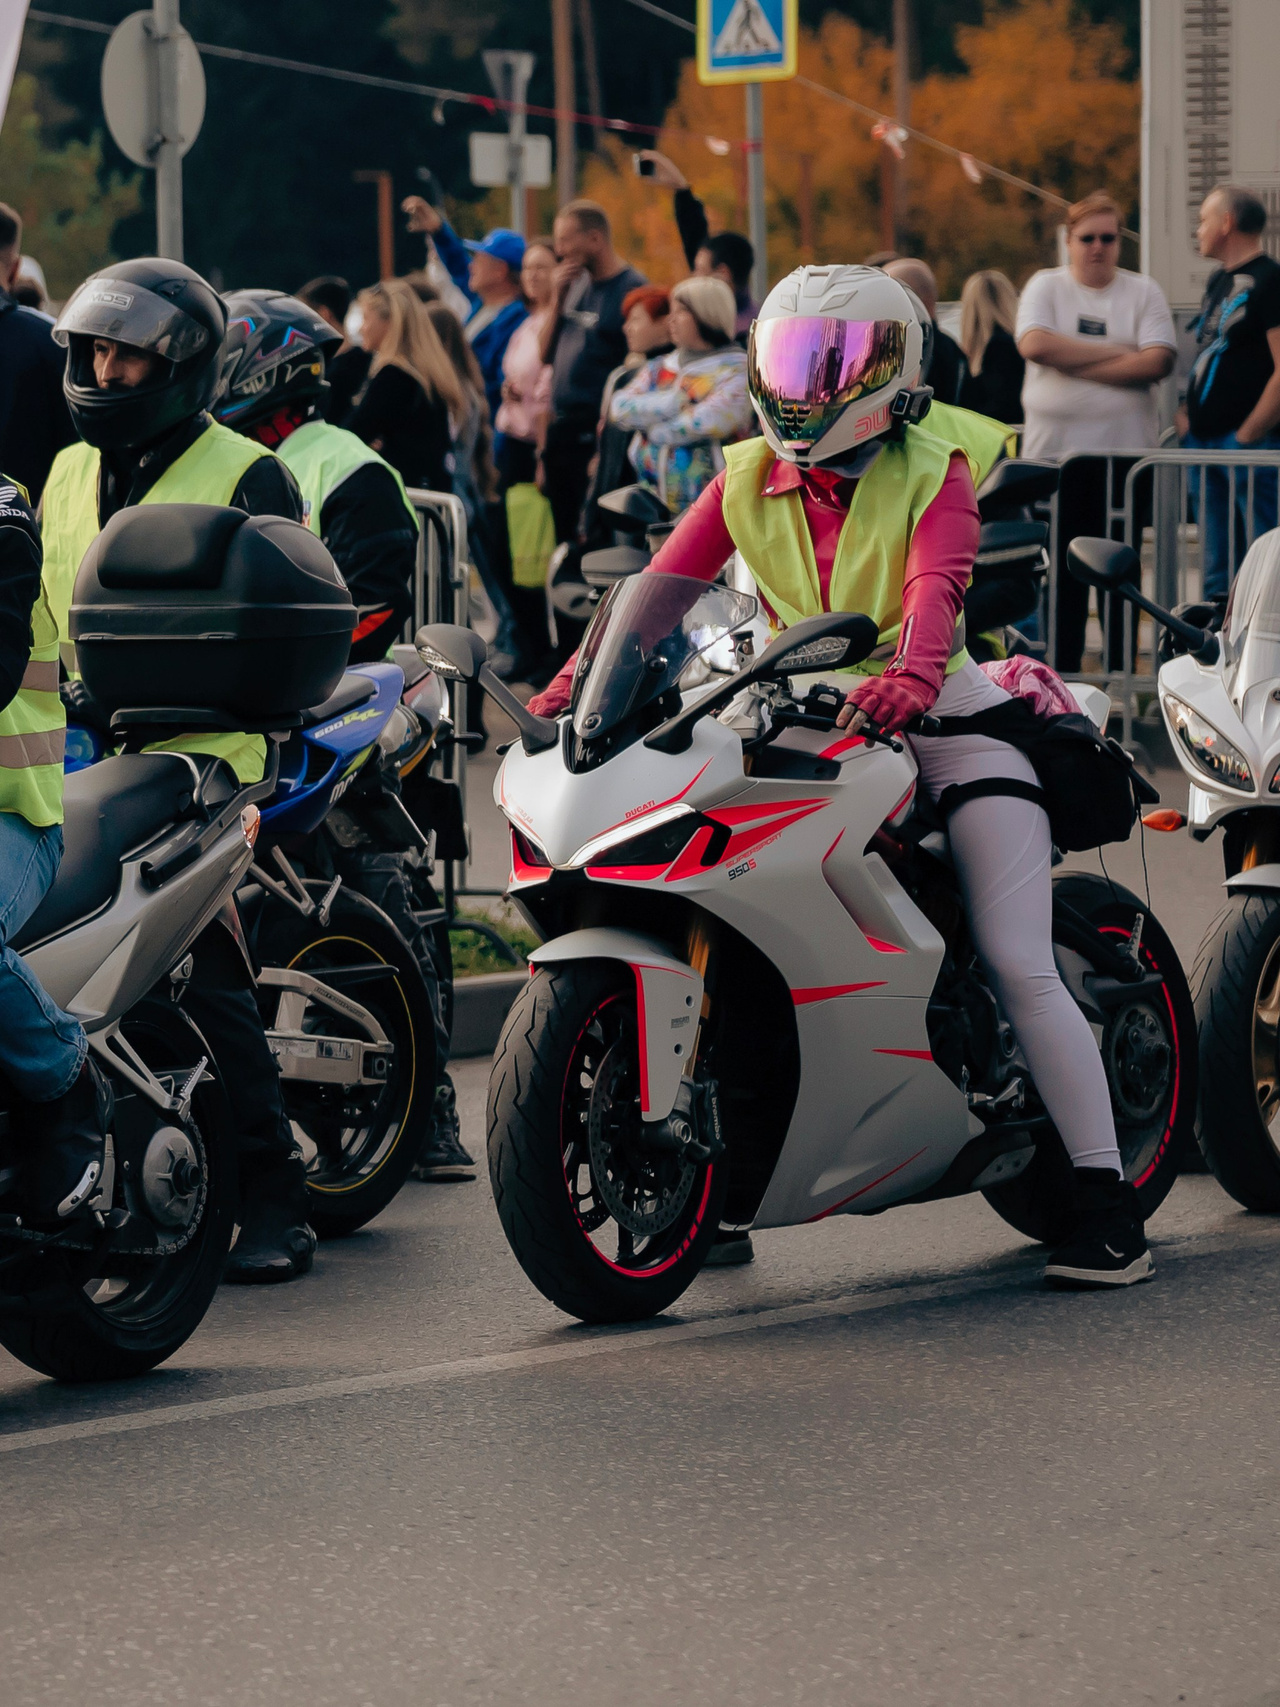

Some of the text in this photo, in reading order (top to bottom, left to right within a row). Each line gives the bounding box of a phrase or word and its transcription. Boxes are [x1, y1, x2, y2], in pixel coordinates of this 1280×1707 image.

[624, 799, 656, 819] DUCATI
[725, 830, 783, 869] SUPERSPORT
[711, 1096, 721, 1140] brembo
